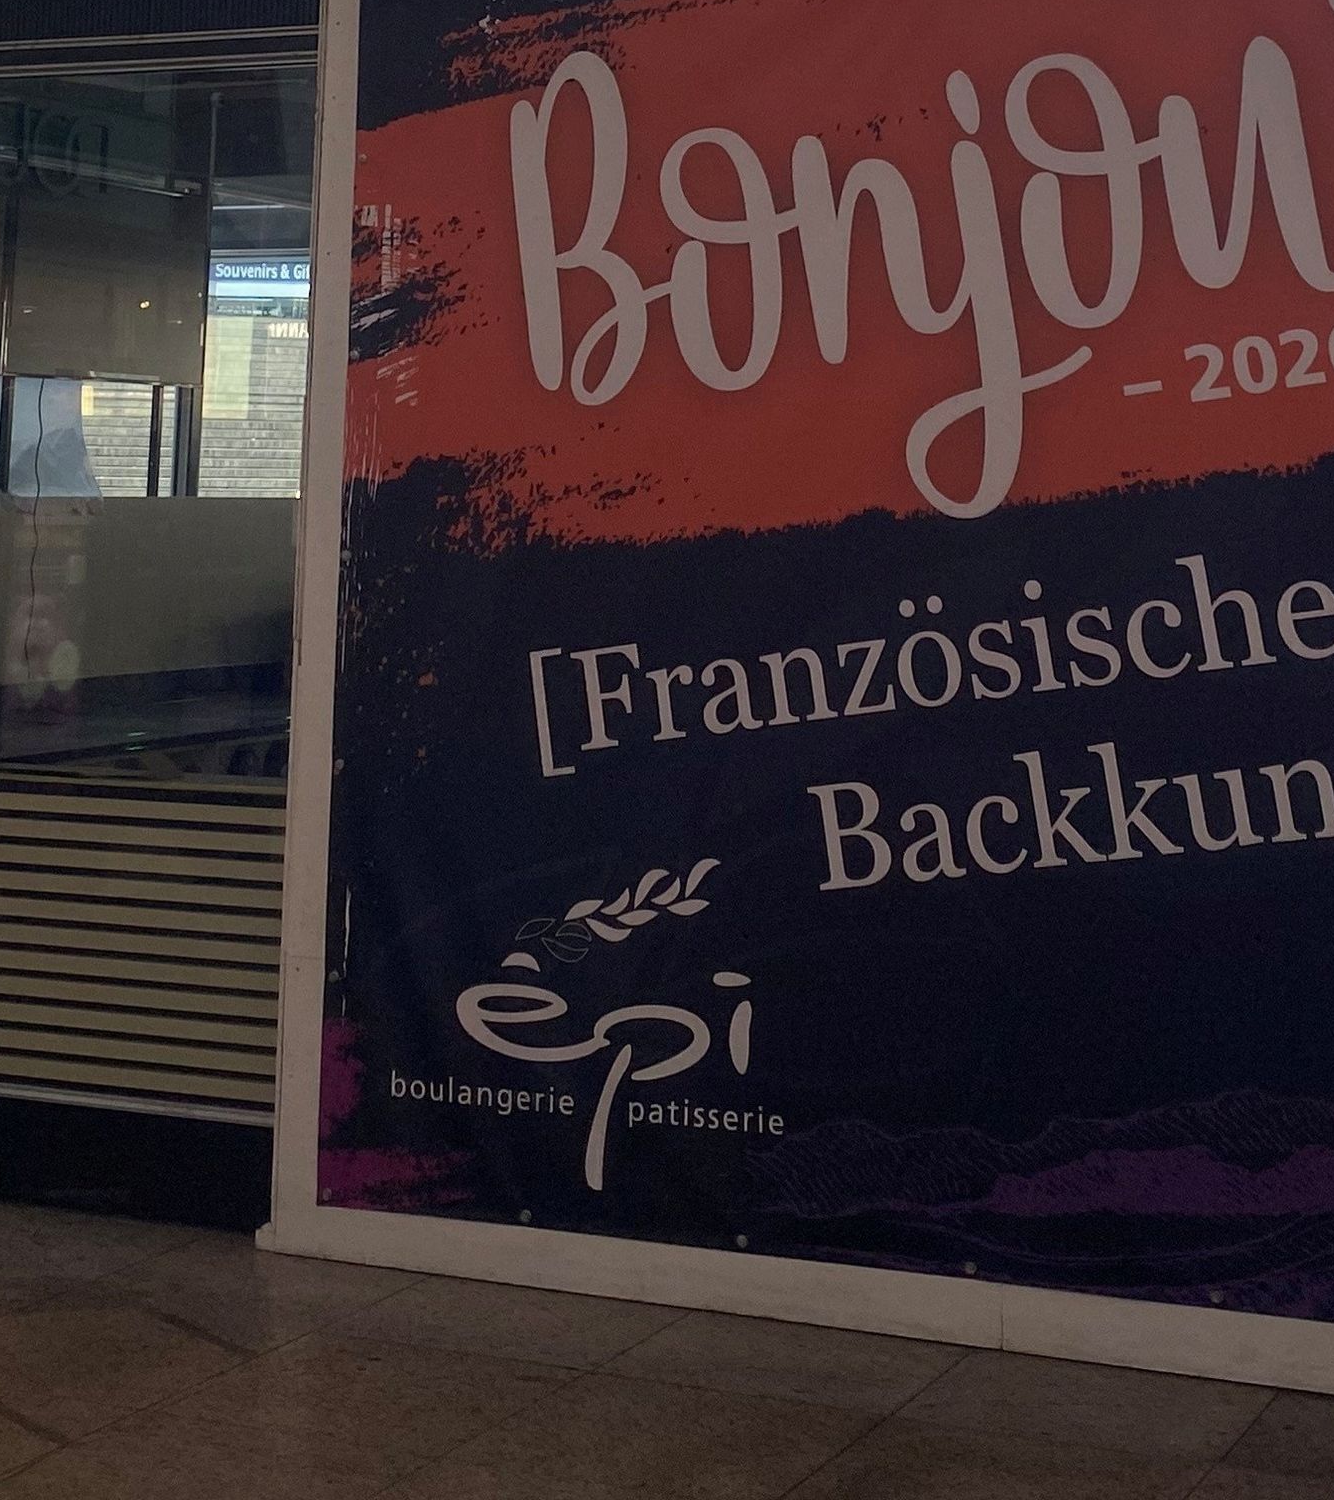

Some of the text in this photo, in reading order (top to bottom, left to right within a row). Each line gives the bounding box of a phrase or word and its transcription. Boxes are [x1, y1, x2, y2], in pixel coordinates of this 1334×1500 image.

[215, 264, 277, 278] Souvenirs
[280, 263, 290, 279] &
[391, 1070, 785, 1135] boulangerie patisserie
